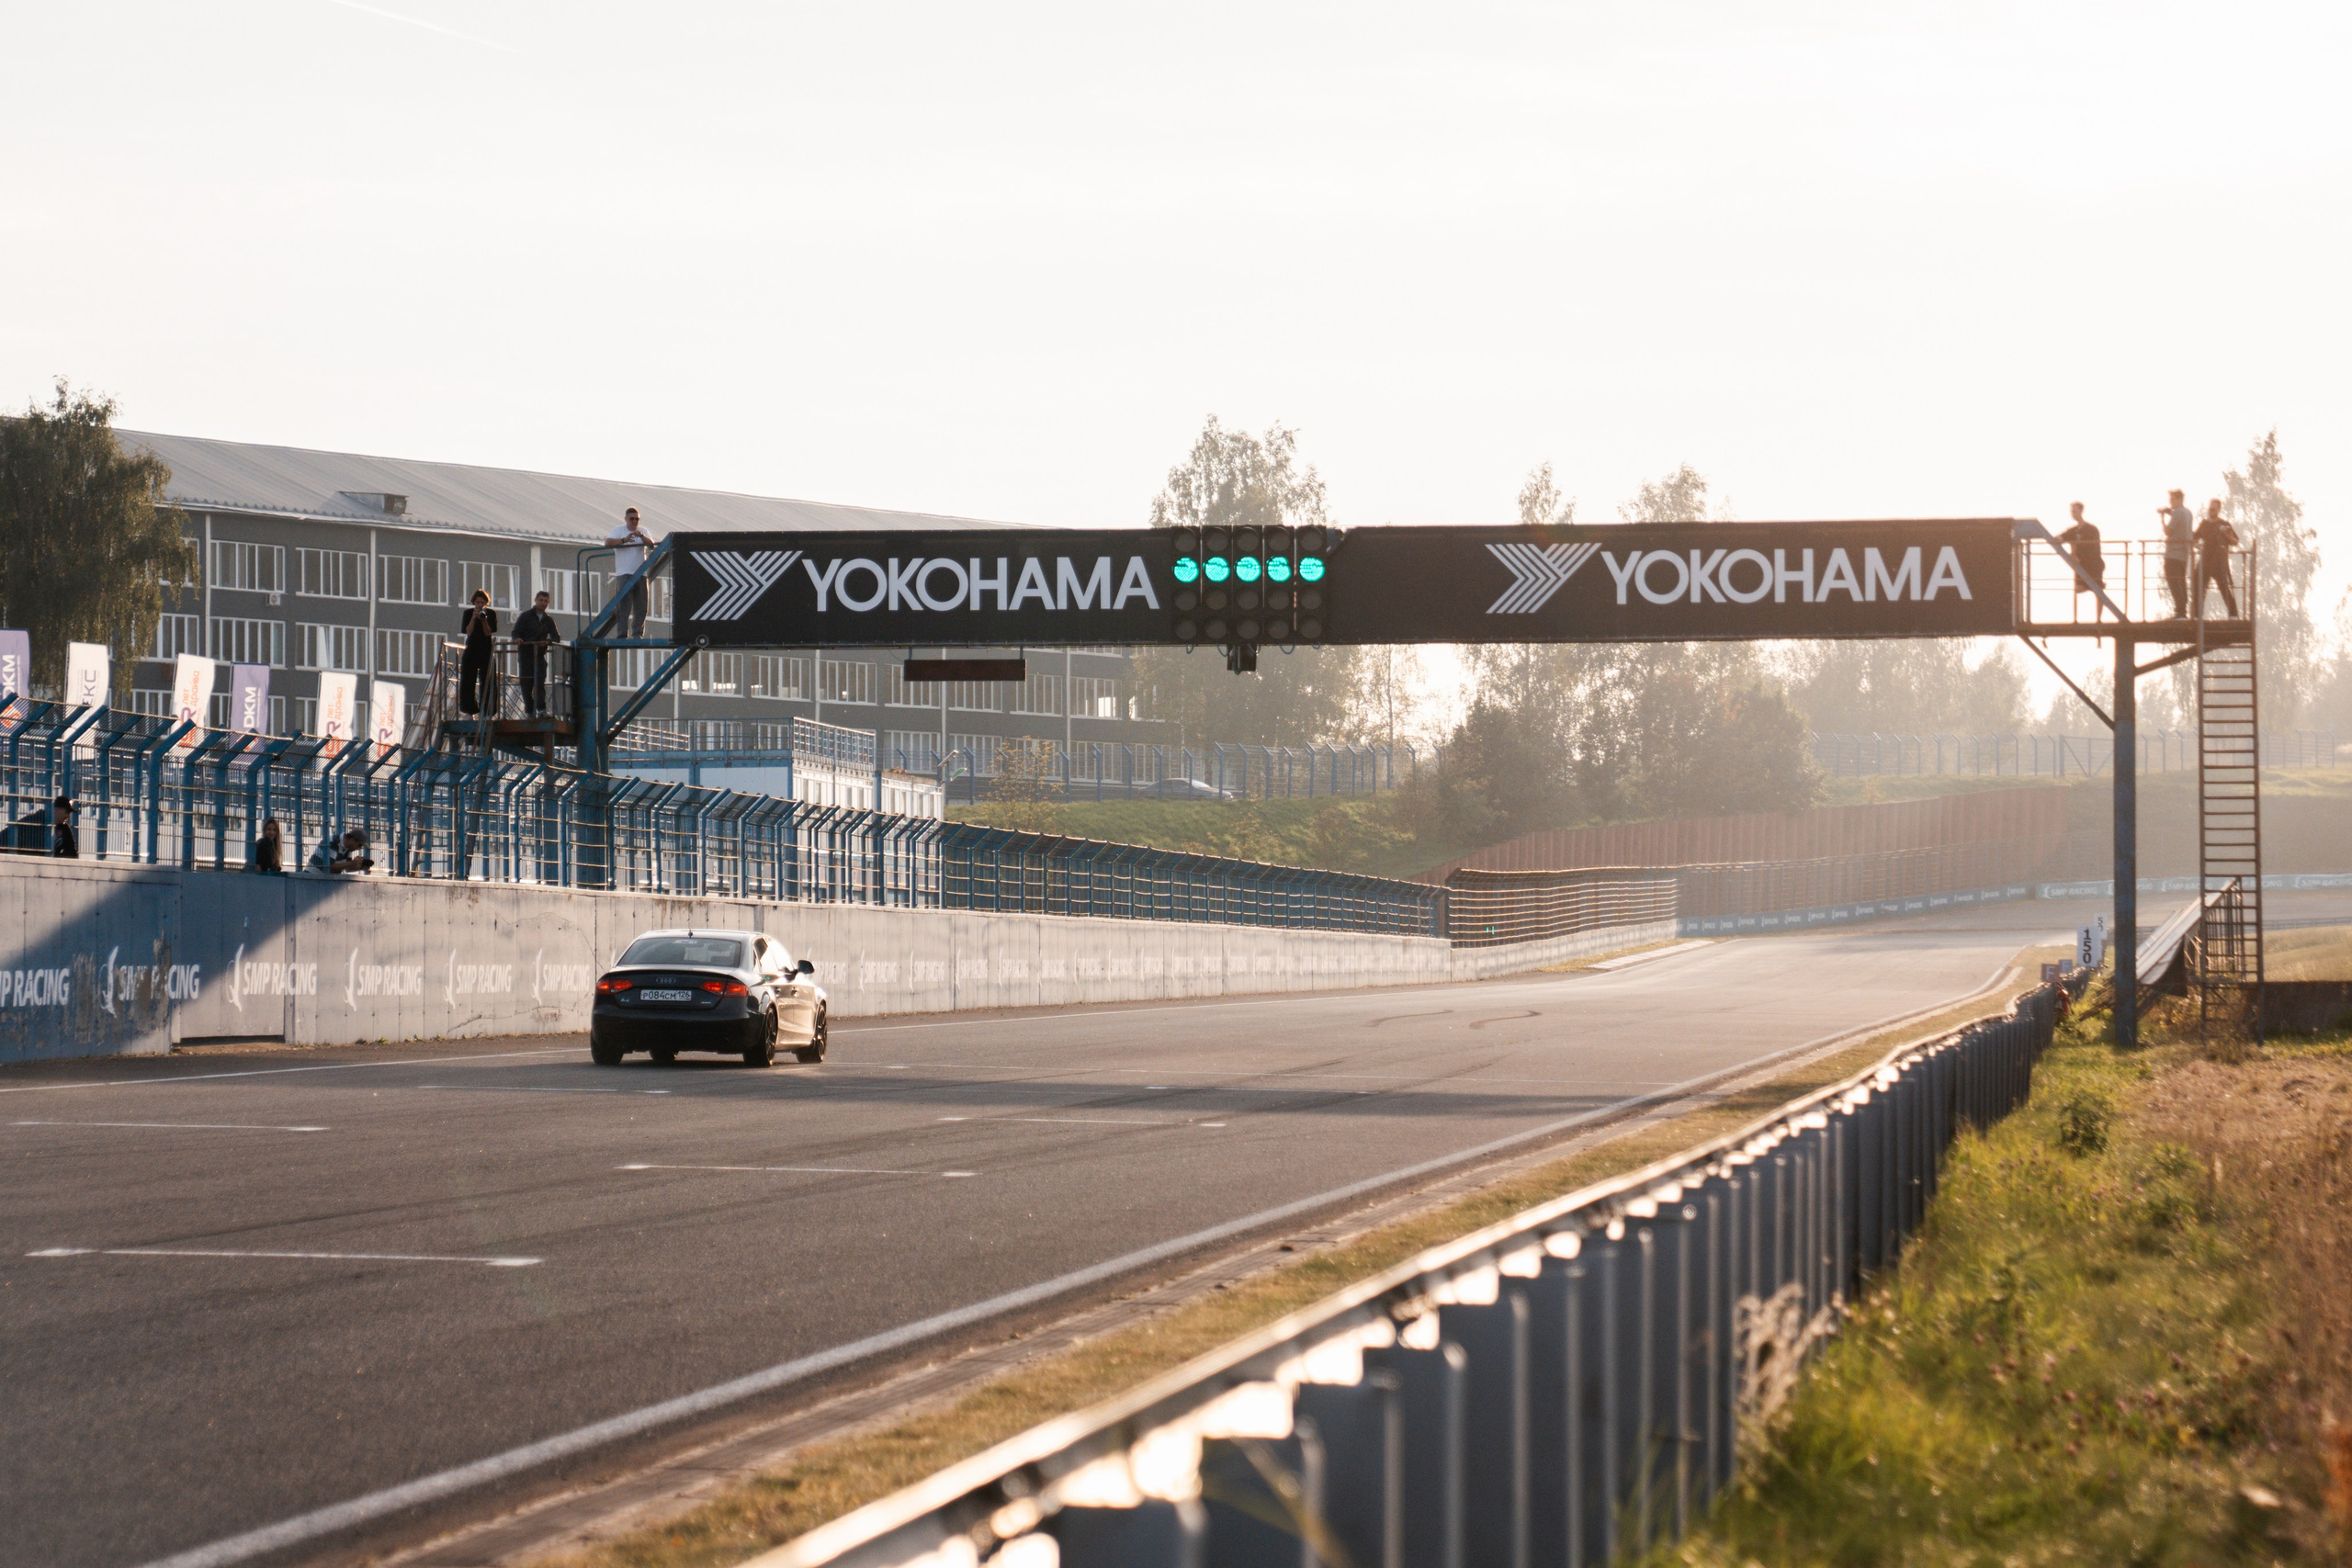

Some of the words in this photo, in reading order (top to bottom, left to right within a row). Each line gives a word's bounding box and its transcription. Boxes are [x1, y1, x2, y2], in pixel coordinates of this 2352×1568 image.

[801, 556, 1159, 612] YOKOHAMA
[1600, 546, 1973, 605] YOKOHAMA
[243, 686, 257, 728] DKM
[2082, 929, 2092, 964] 150
[13, 967, 71, 1007] RACING
[243, 962, 270, 996] SMP
[271, 962, 318, 996] RACING
[356, 964, 382, 996] SMP
[382, 965, 422, 996] RACING
[456, 964, 476, 994] SMP
[478, 964, 513, 993] RACING
[543, 964, 560, 991] SMP
[560, 964, 590, 992] RACING
[2045, 965, 2056, 981] F
[677, 991, 691, 999] 126
